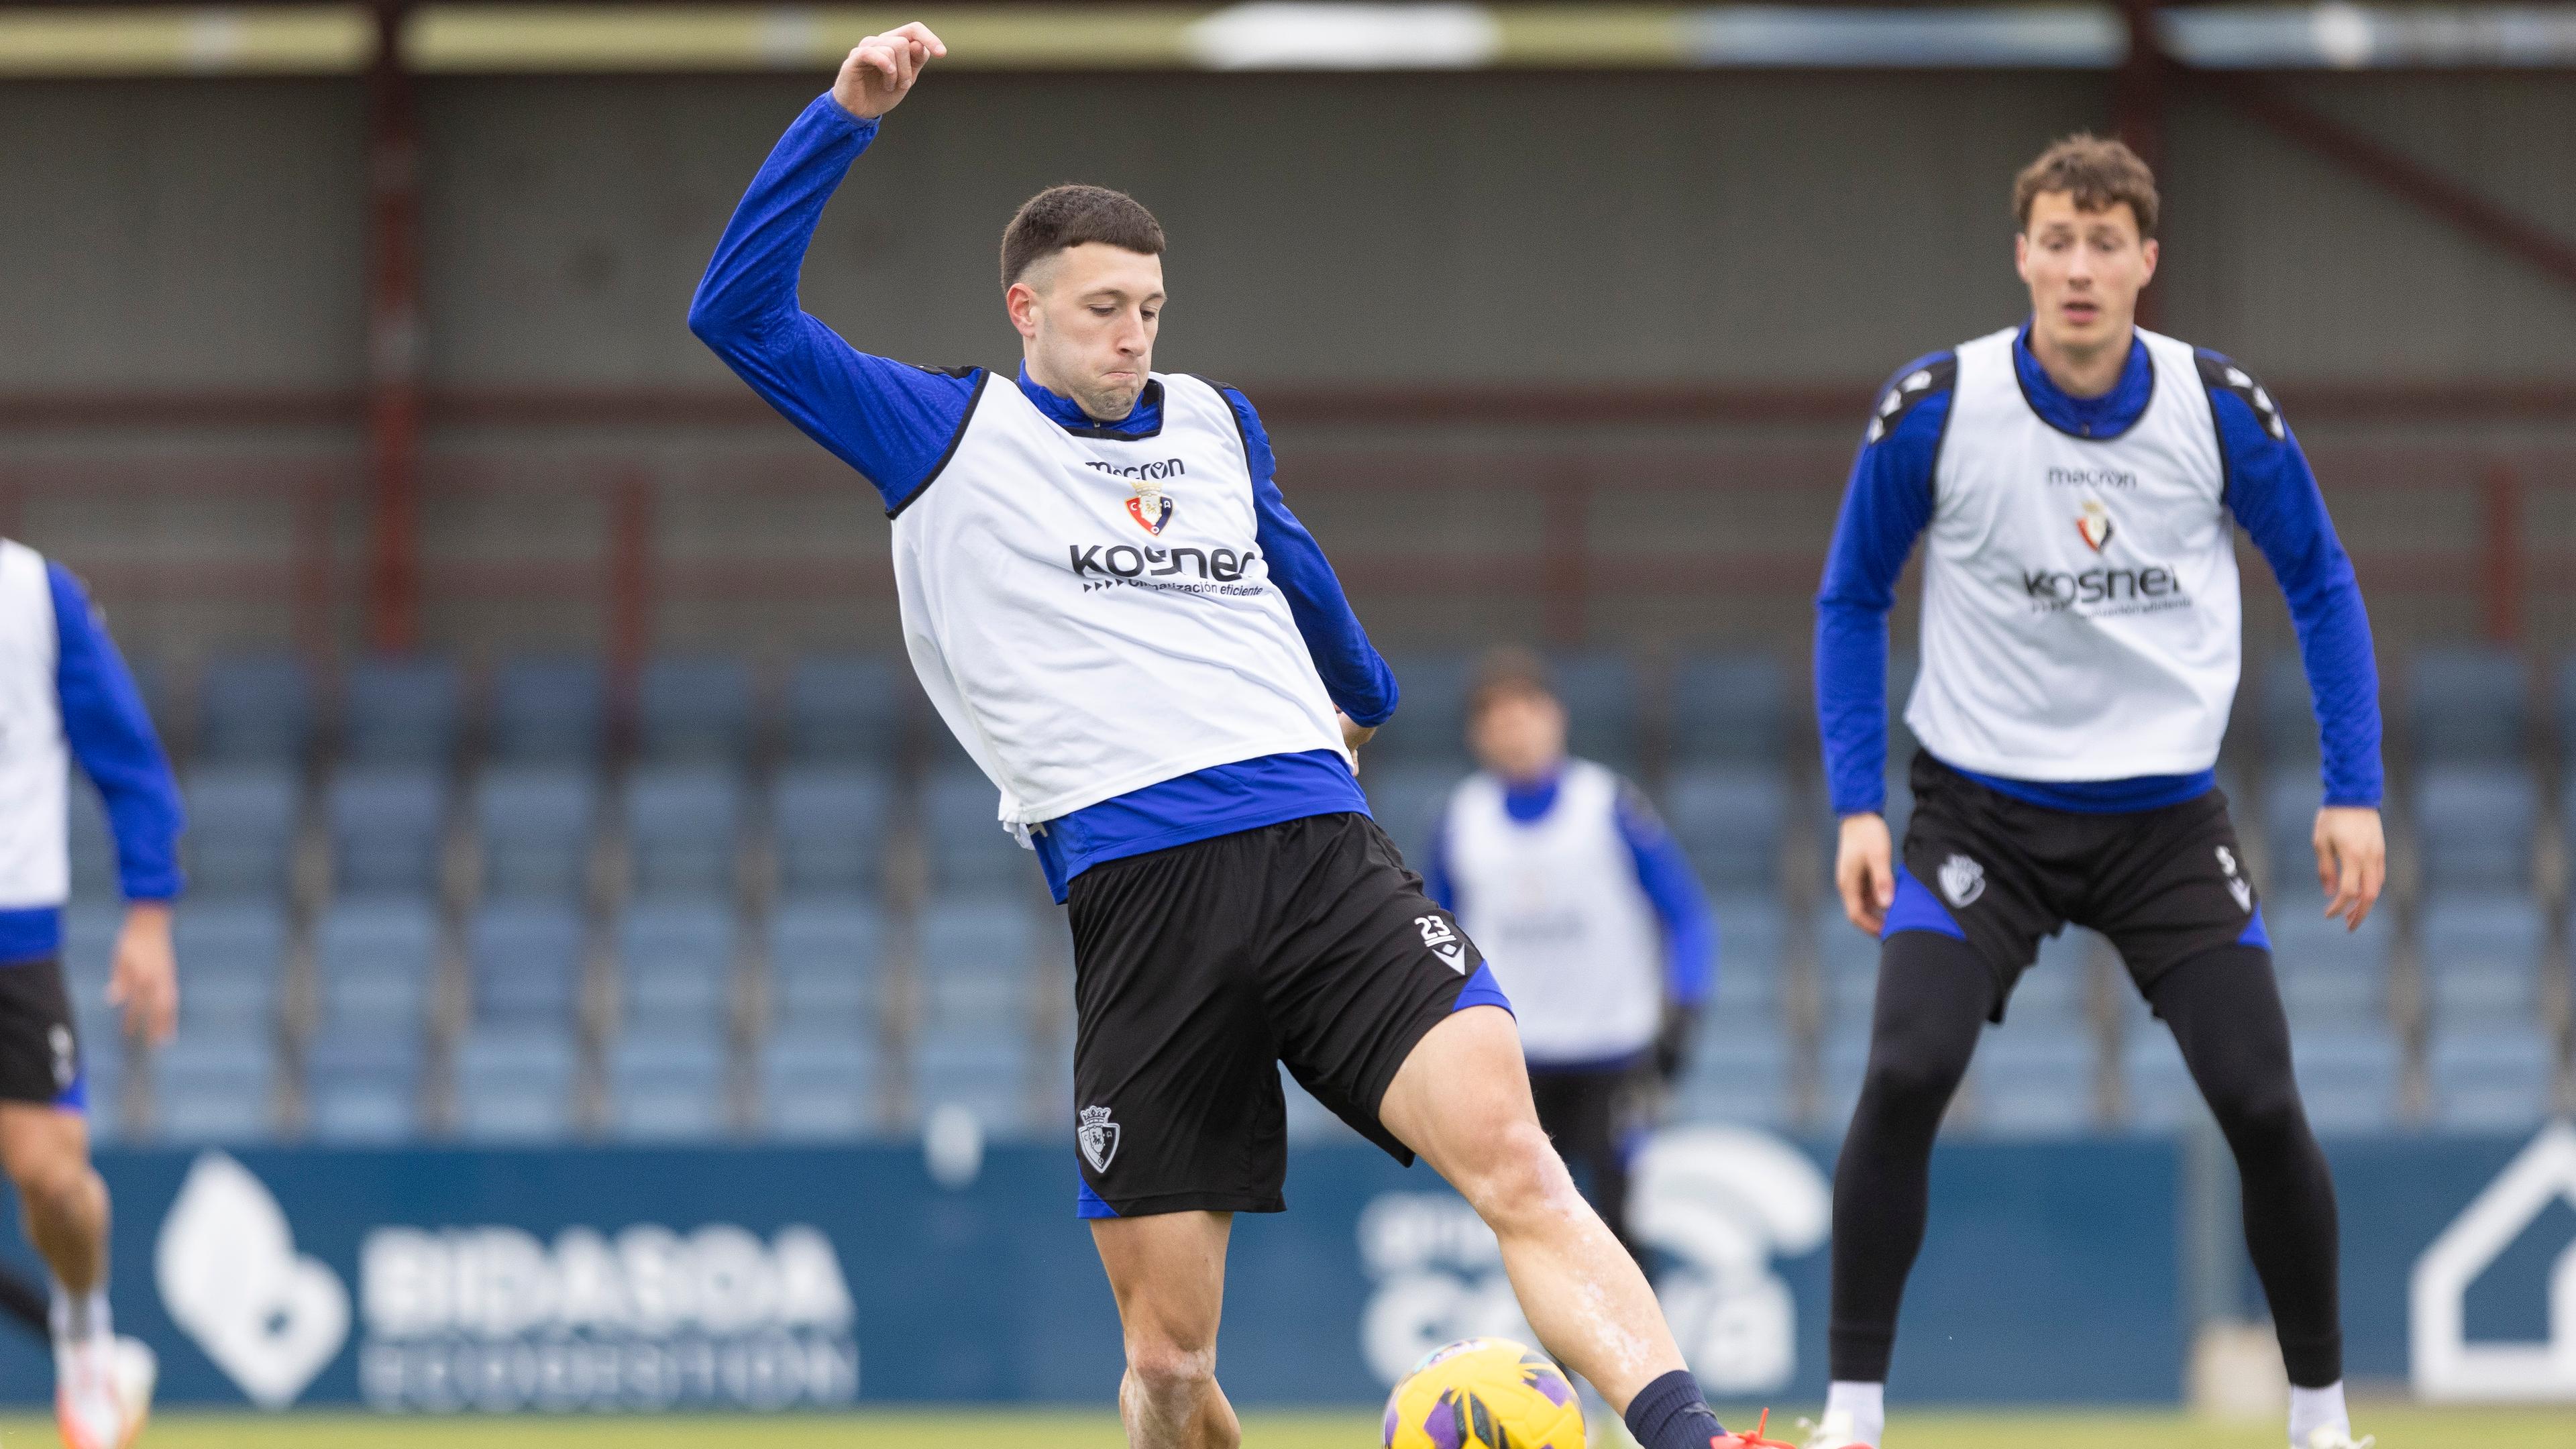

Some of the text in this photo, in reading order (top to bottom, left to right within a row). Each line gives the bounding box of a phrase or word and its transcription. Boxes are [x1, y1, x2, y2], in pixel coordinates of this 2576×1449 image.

[1220, 584, 1264, 596] eficiente
[1413, 914, 1452, 941] 23
[362, 1226, 855, 1336] BIDASOA
